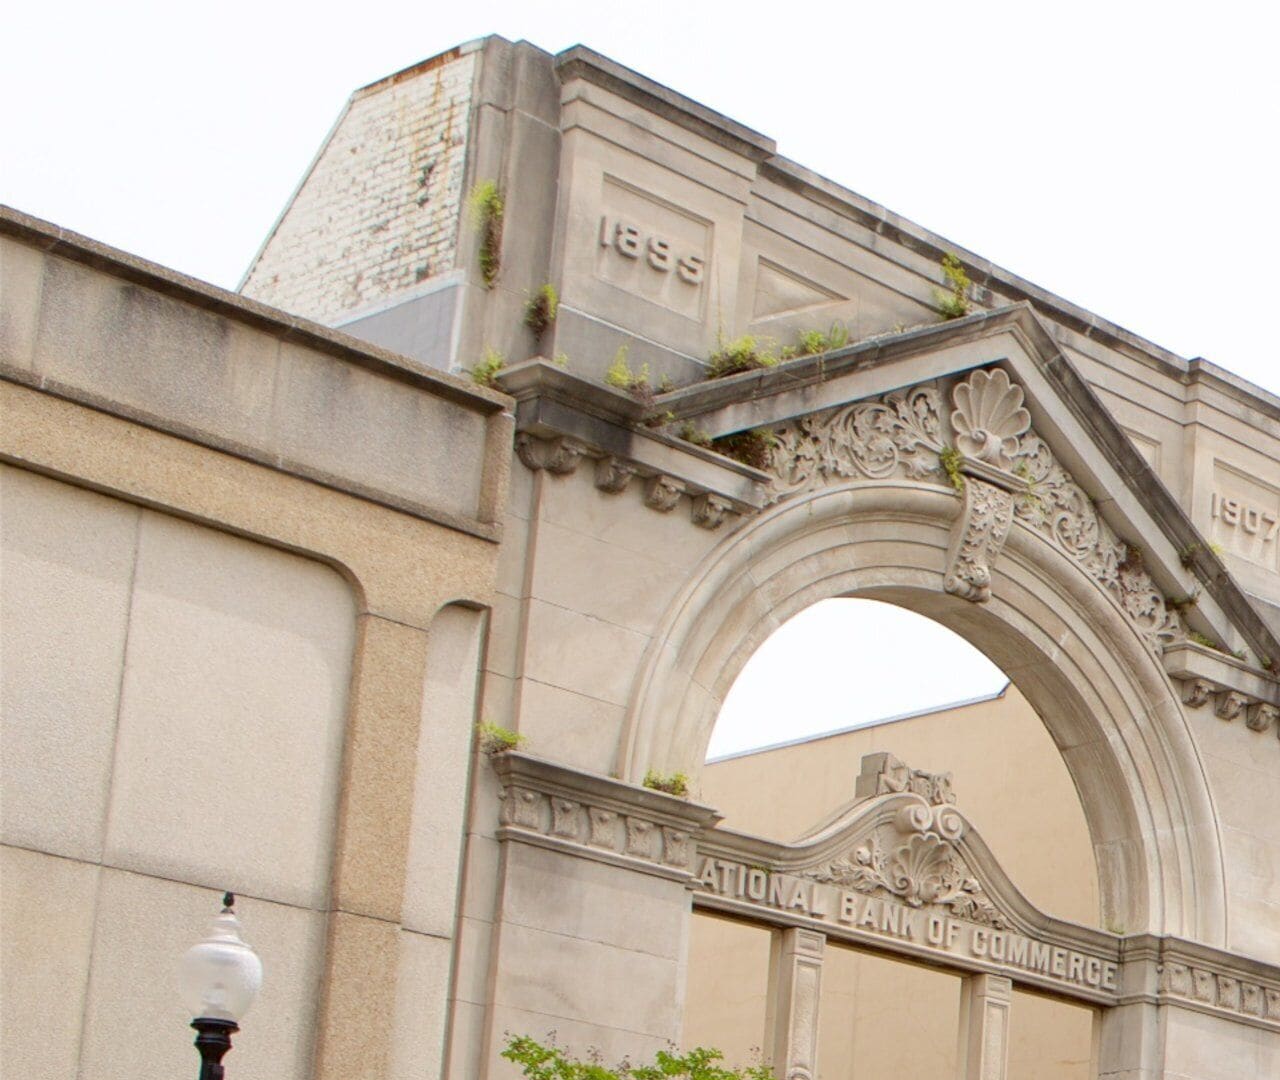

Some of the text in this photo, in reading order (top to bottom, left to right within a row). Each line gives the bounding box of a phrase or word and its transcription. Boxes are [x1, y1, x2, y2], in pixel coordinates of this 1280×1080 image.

[600, 215, 704, 286] 1895
[1211, 493, 1280, 542] 1907
[701, 857, 1119, 991] ATIONAL BANK OF COMMERCE
